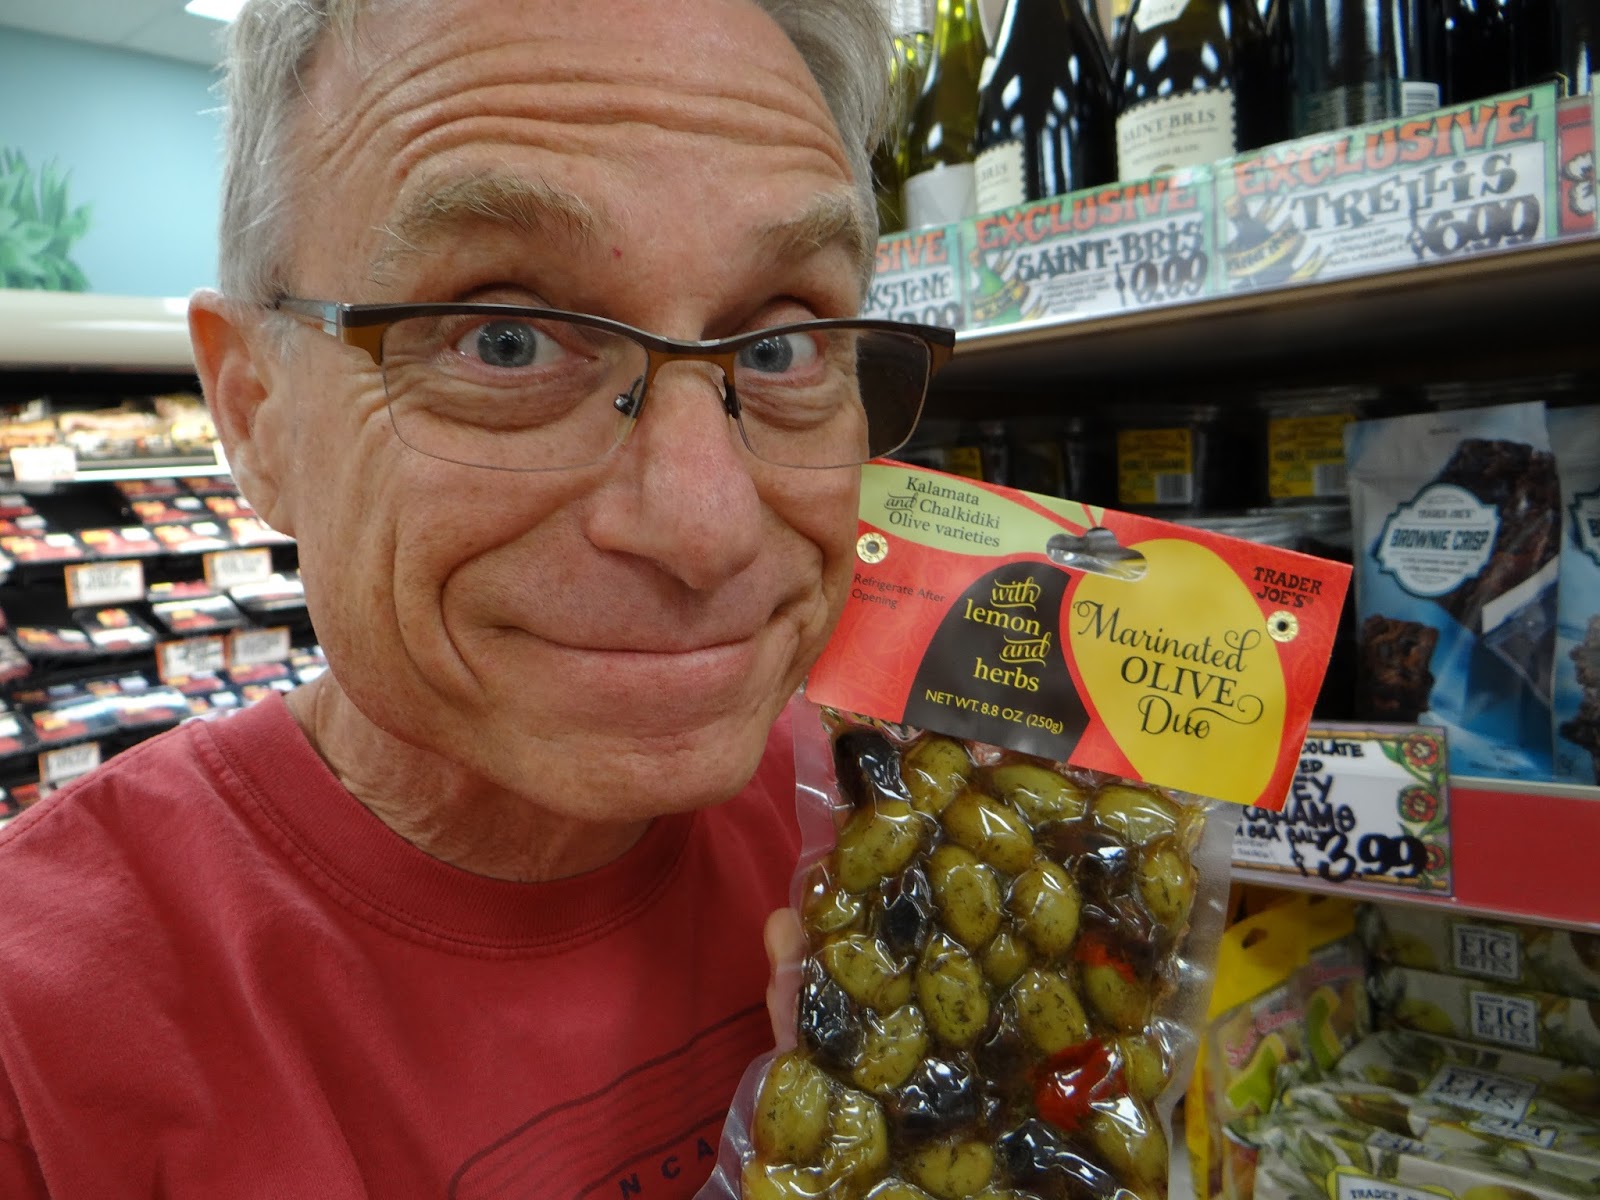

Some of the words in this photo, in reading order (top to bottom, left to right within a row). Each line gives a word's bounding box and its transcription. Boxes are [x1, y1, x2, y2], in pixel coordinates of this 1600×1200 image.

[1233, 94, 1539, 197] EXCLUSIVE
[976, 175, 1196, 249] EXCLUSIVE
[875, 229, 947, 273] SIVE
[906, 476, 980, 506] Kalamata
[884, 492, 919, 513] and
[919, 498, 1000, 530] Chalkidiki
[889, 511, 931, 532] Olive
[935, 523, 1000, 548] varieties
[1390, 528, 1450, 549] BROWNIE
[1452, 528, 1490, 551] CRISP
[854, 573, 914, 596] Refrigerate
[917, 588, 946, 603] After
[990, 576, 1041, 613] with
[1253, 566, 1323, 595] TRADER
[1256, 585, 1308, 609] JOE'S
[851, 588, 897, 610] Opening
[963, 598, 1041, 637] lemon
[999, 632, 1052, 668] and
[1073, 600, 1262, 673] Marinated
[973, 657, 1040, 692] herbs
[1121, 656, 1238, 708] OLIVE
[925, 689, 954, 706] NET
[955, 695, 978, 712] WT.
[980, 702, 999, 717] 8.8
[1001, 707, 1024, 722] OZ
[1026, 713, 1064, 735] (250g)
[1138, 694, 1264, 739] Duo
[1301, 739, 1364, 757] OLATE
[1300, 759, 1323, 774] ED
[1291, 774, 1334, 803] EY
[1460, 933, 1513, 960] FIG
[1477, 1002, 1530, 1030] FIG
